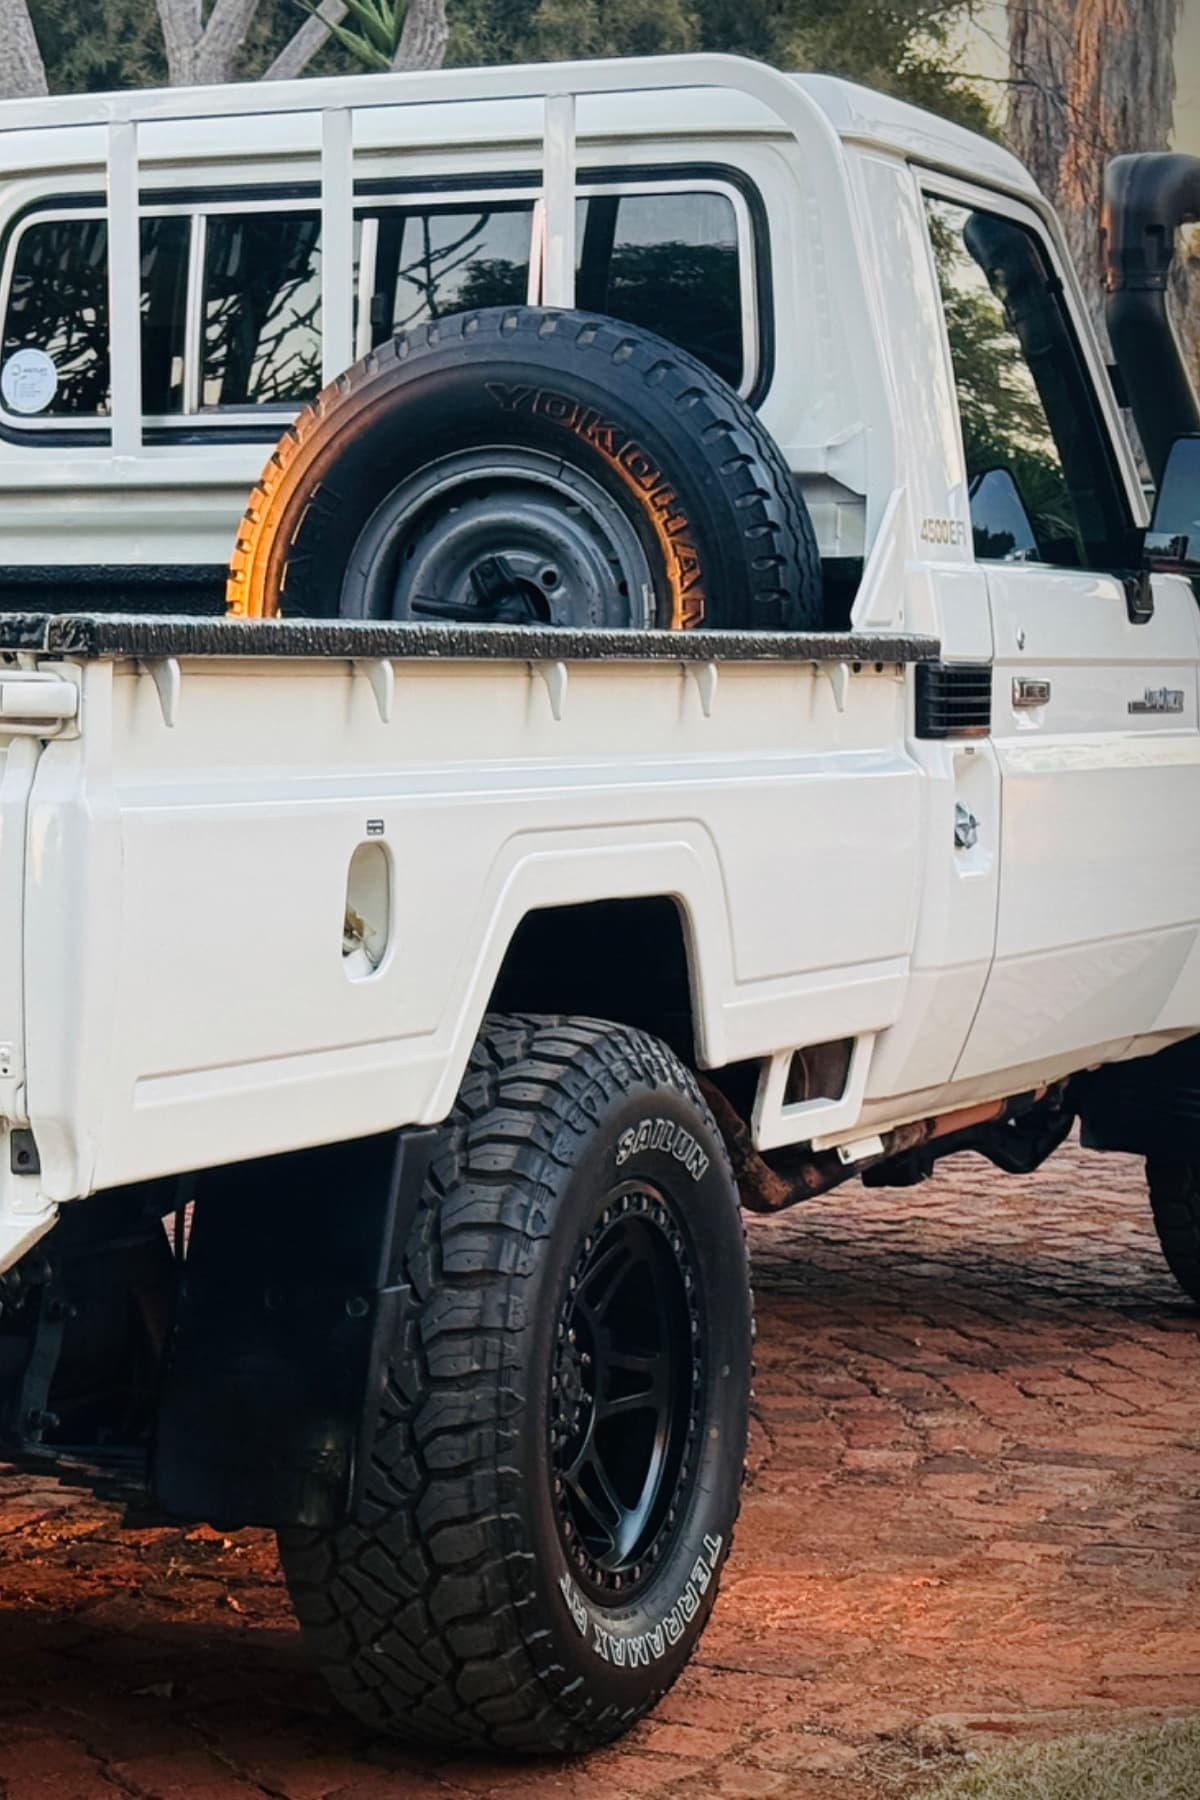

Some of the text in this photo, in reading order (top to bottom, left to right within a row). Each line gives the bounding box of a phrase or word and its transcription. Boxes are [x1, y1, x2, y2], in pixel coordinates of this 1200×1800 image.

[484, 383, 705, 629] YOKOHAM
[615, 1118, 709, 1181] SAILUN
[593, 1533, 723, 1668] TERRAMAX
